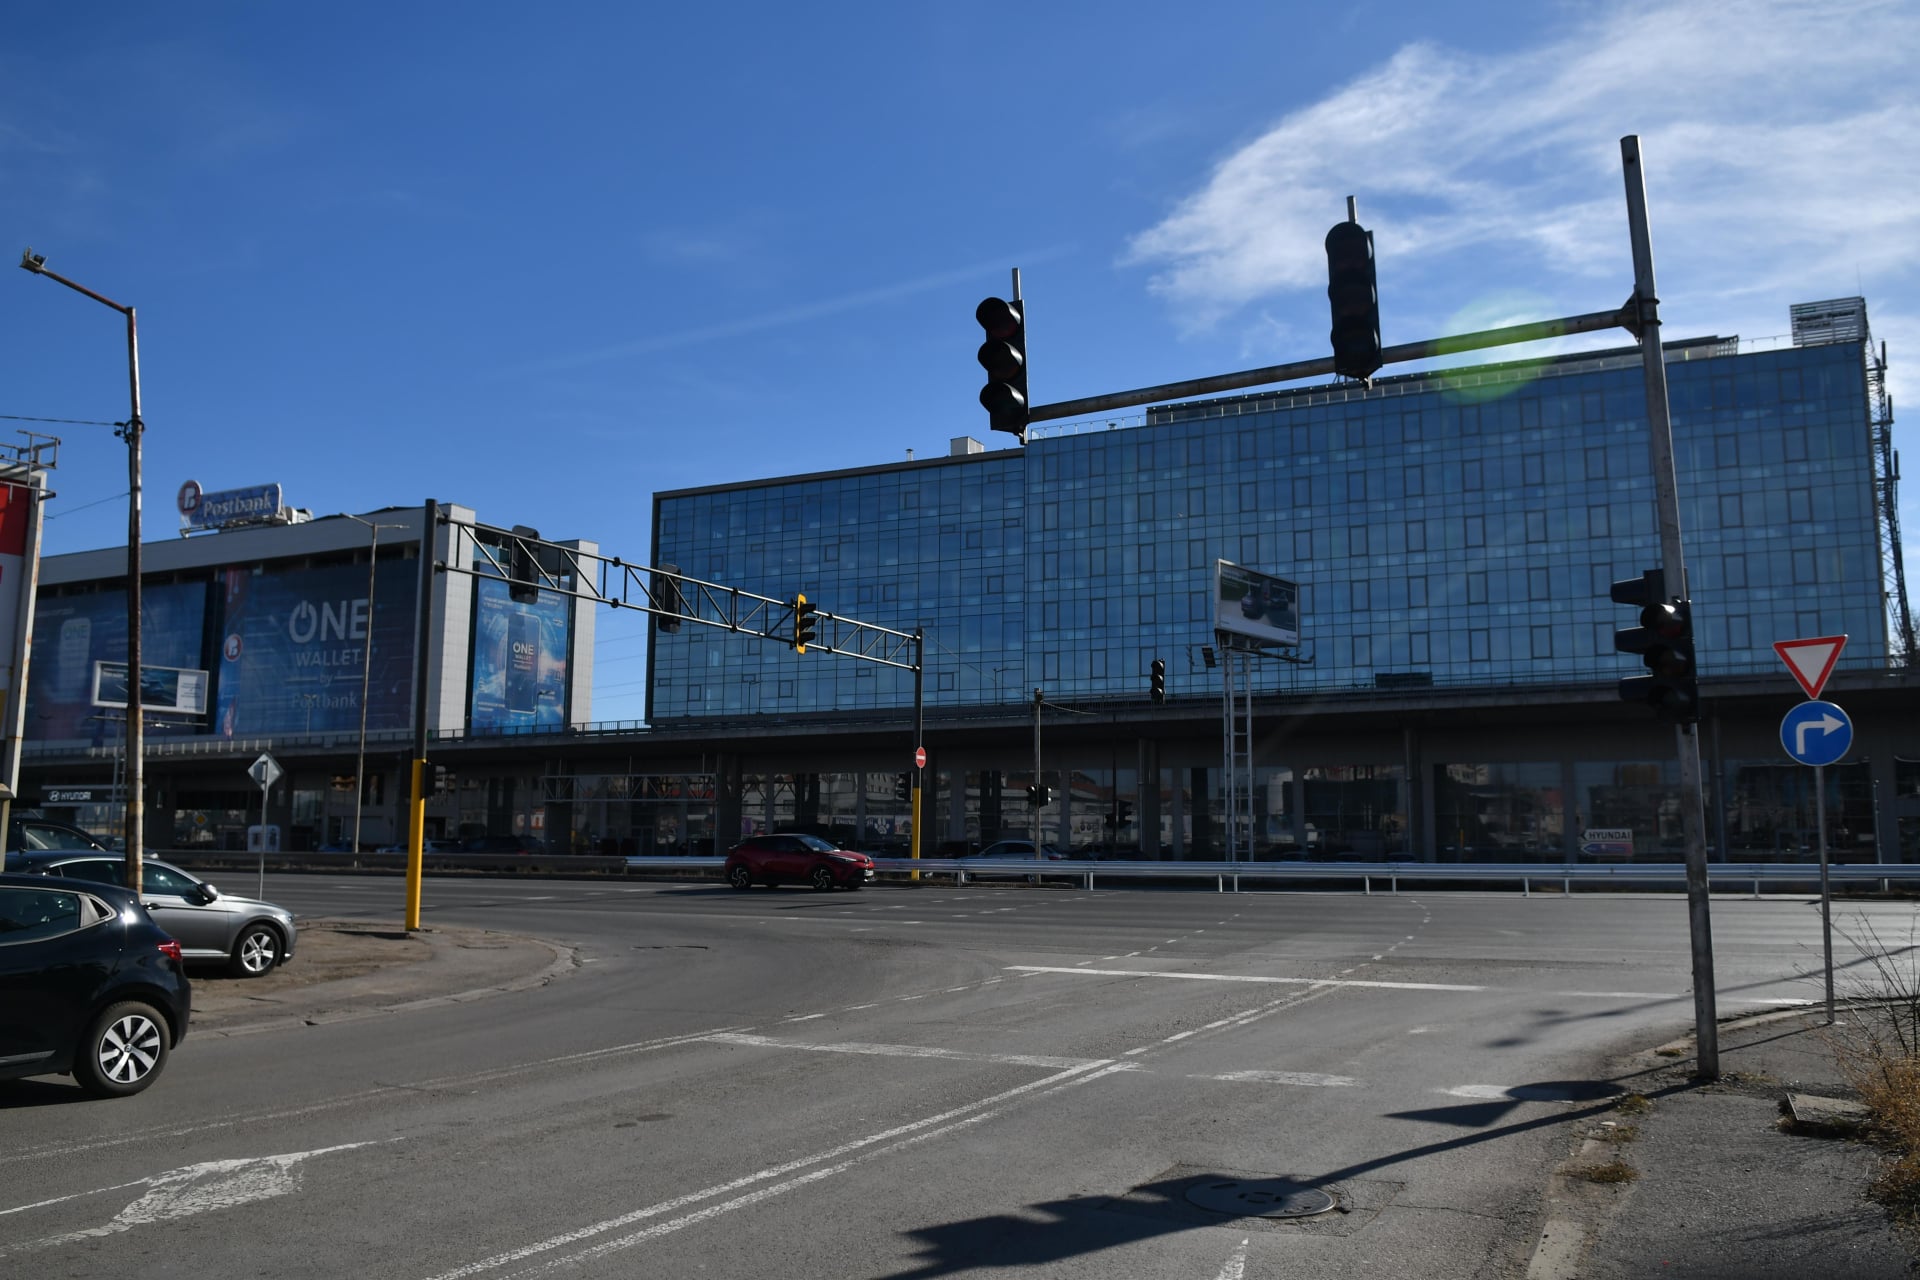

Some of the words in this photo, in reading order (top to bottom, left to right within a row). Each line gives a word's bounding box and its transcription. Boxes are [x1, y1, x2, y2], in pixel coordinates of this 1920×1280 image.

[203, 490, 273, 517] Postbank
[288, 598, 370, 644] ONE
[295, 648, 361, 667] WALLET
[513, 641, 535, 656] ONE
[319, 673, 335, 687] by
[291, 690, 358, 710] Postbank
[1589, 831, 1632, 840] HYUNDAI
